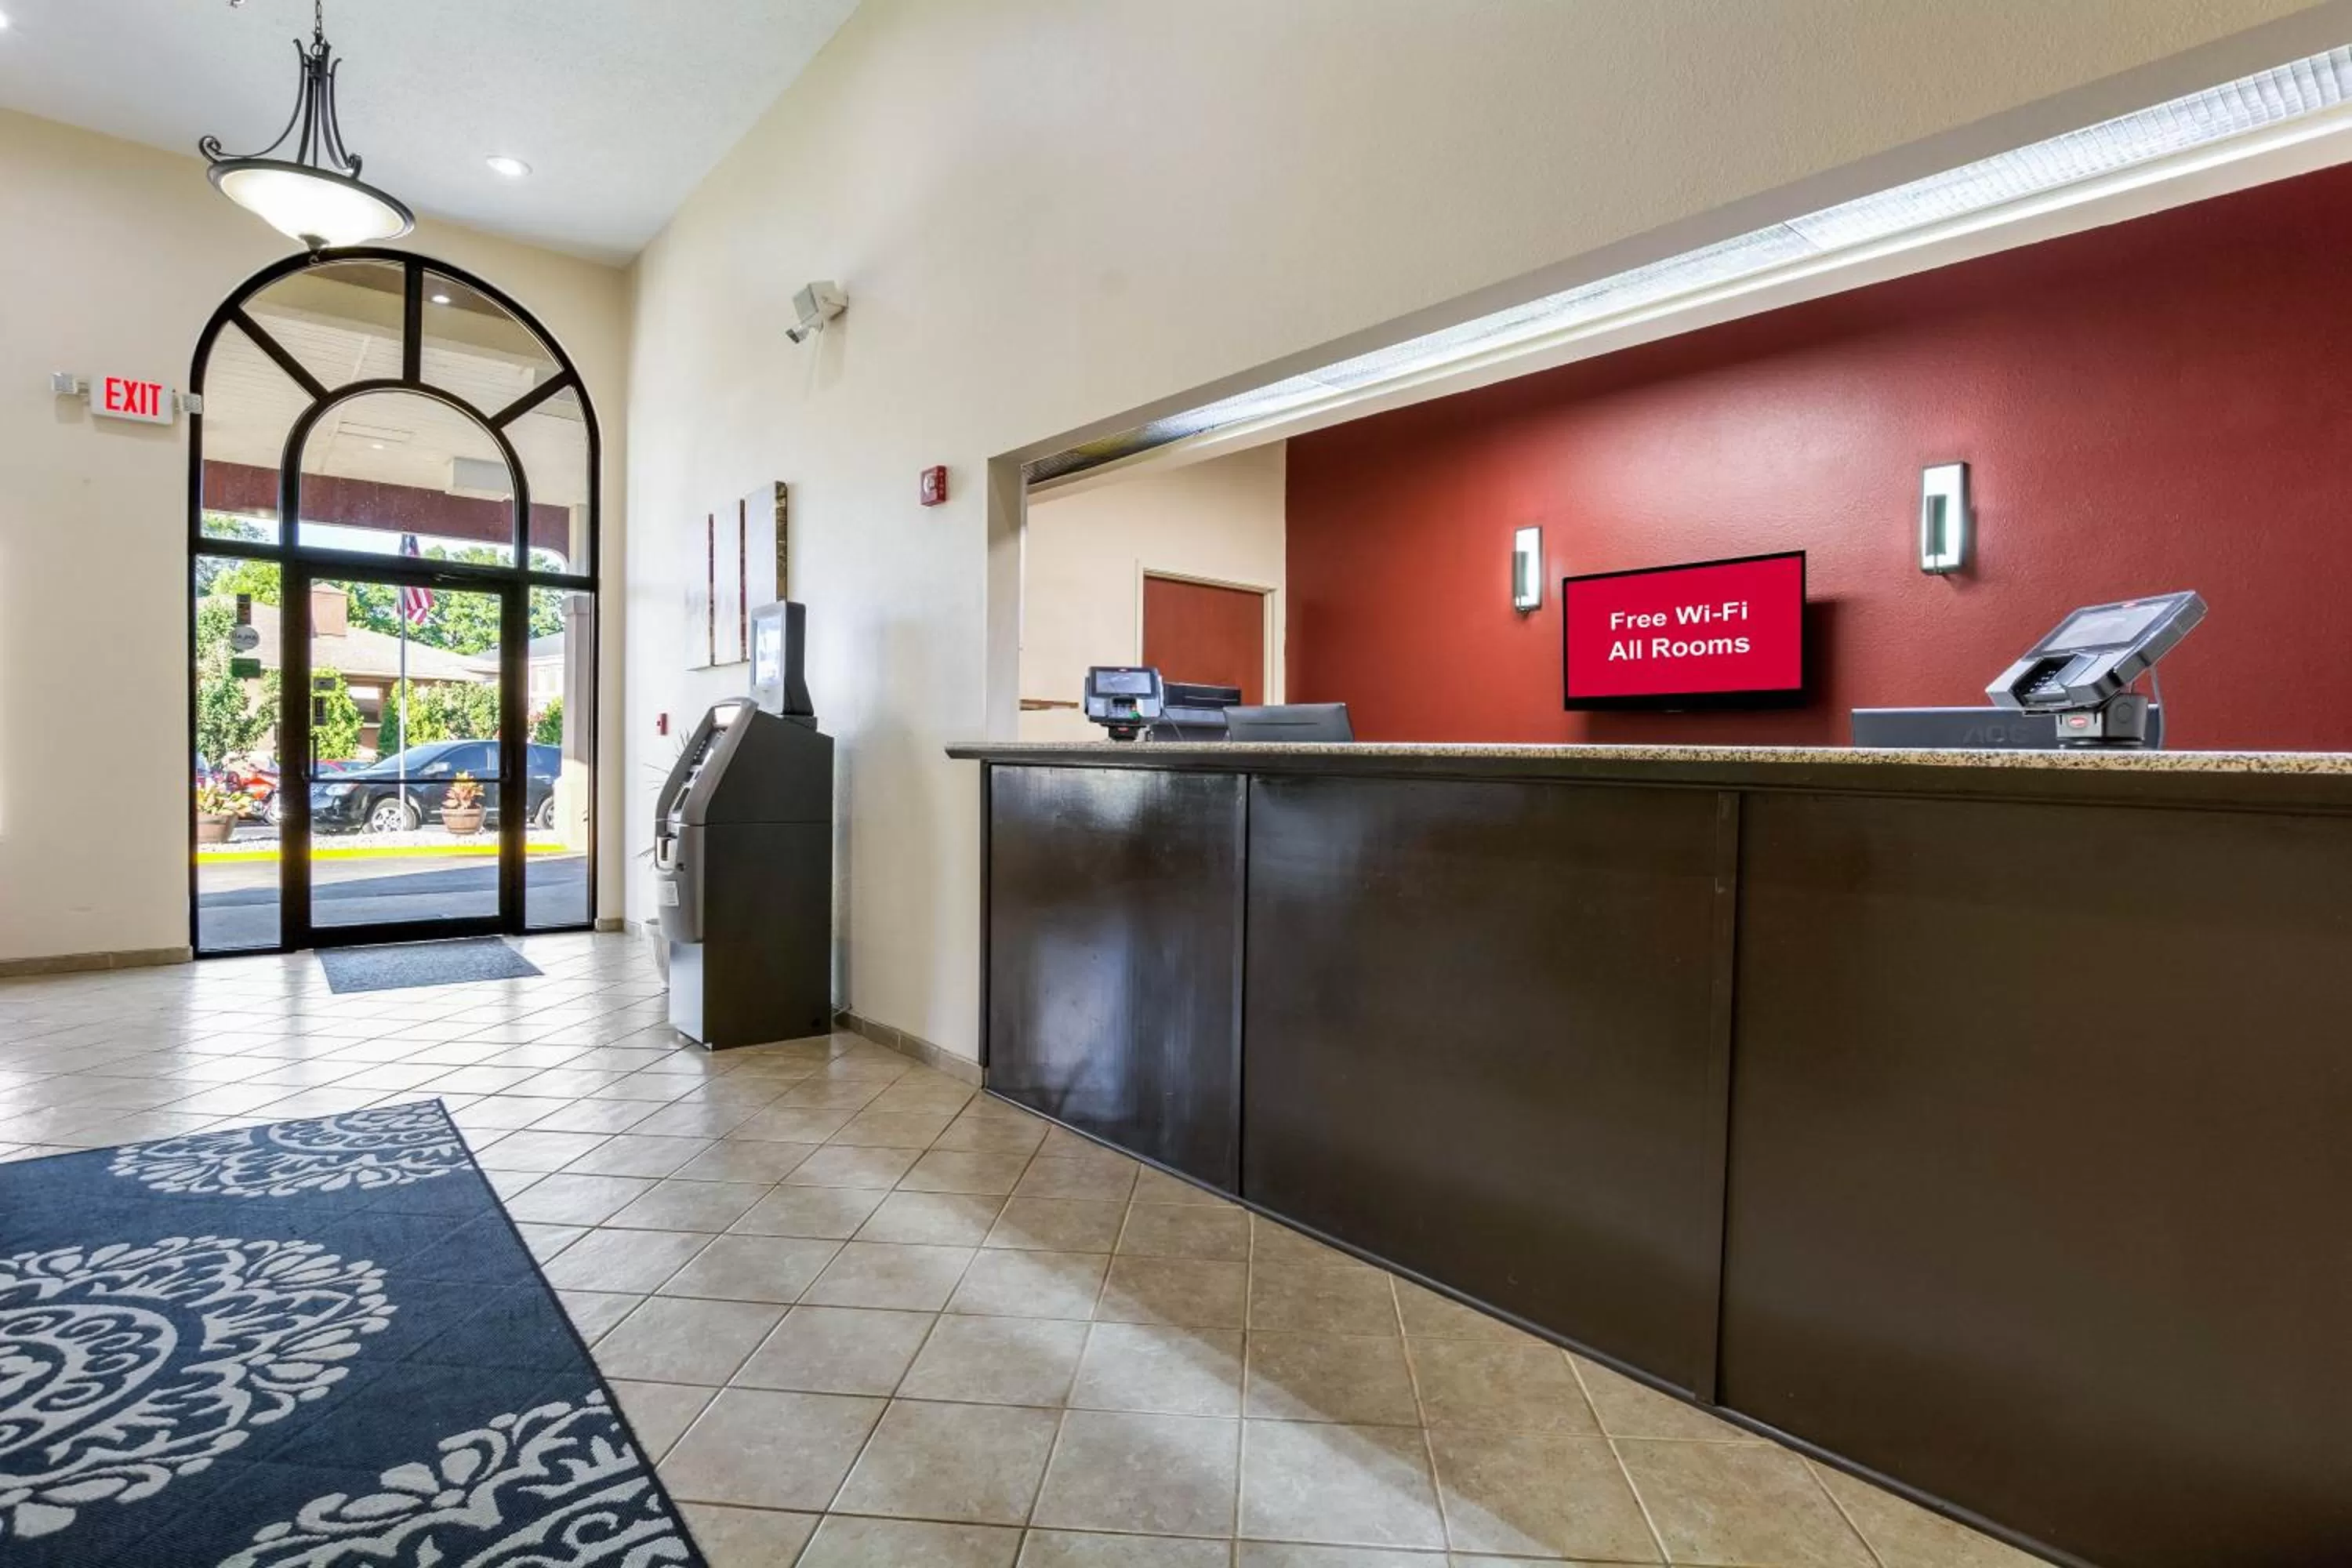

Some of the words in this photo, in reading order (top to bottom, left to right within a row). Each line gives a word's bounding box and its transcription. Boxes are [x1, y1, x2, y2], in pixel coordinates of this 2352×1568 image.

[106, 376, 162, 416] EXIT
[1610, 612, 1668, 630] Free
[1675, 601, 1748, 625] Wi-Fi
[1608, 639, 1642, 661] All
[1651, 637, 1751, 659] Rooms
